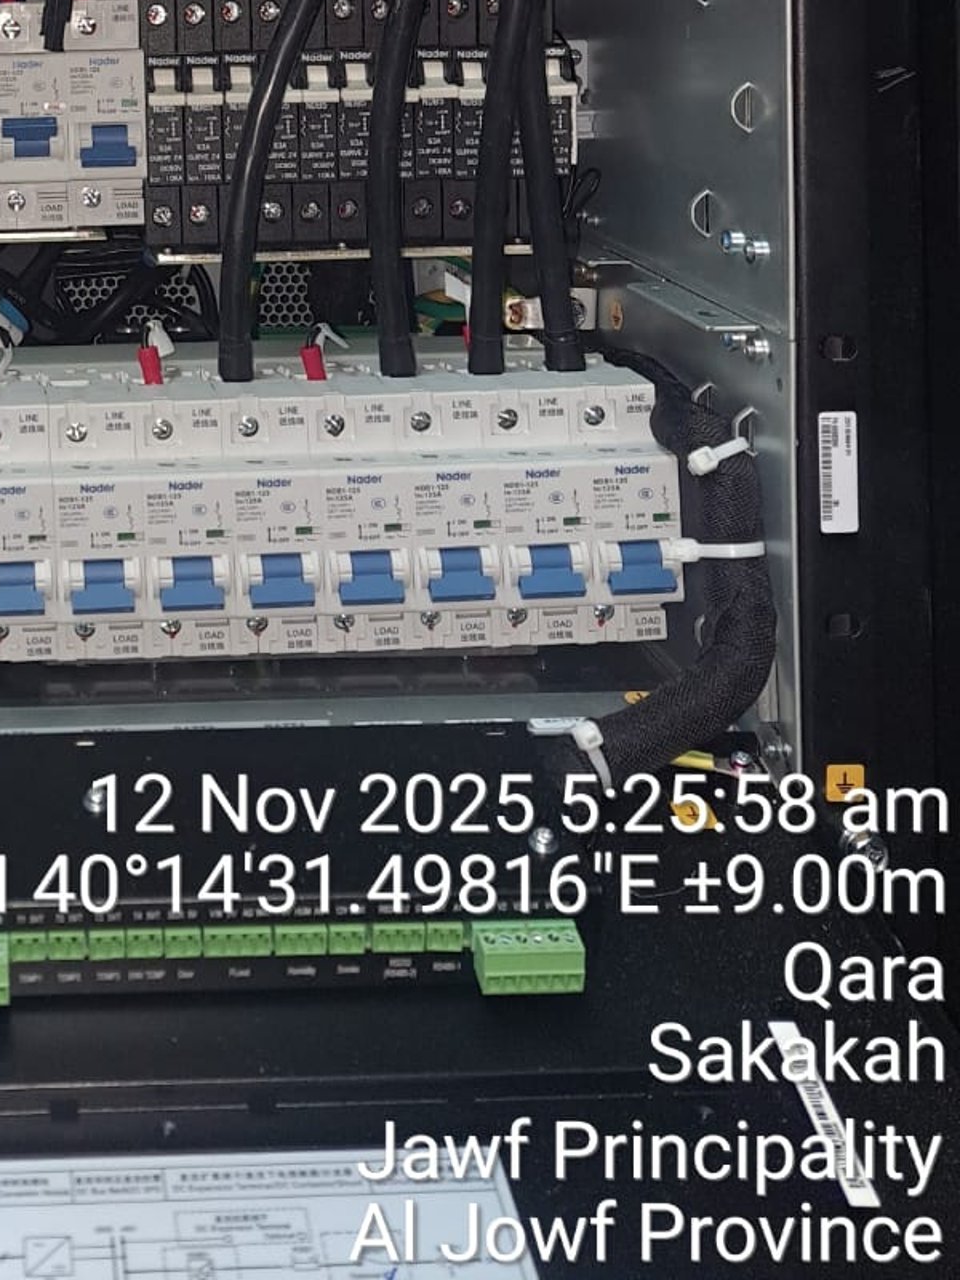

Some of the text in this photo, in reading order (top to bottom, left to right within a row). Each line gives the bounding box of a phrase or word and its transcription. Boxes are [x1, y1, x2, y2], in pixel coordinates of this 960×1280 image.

[225, 54, 257, 63] Nader
[302, 53, 333, 62] Nader
[340, 51, 372, 60] Nader
[418, 50, 448, 58] Nader
[148, 57, 180, 66] Nader
[187, 56, 218, 65] Nader
[452, 399, 472, 409] LINE
[539, 398, 558, 407] LINE
[192, 408, 212, 417] LINE
[278, 406, 299, 415] LINE
[364, 403, 385, 413] LINE
[19, 414, 39, 423] LINE
[105, 411, 125, 420] LINE
[525, 469, 561, 480] Nader
[614, 464, 650, 476] Nader
[347, 474, 383, 486] Nader
[436, 472, 472, 483] Nader
[168, 481, 204, 492] Nader
[257, 478, 292, 489] Nader
[80, 483, 116, 494] Nader
[547, 620, 573, 630] LOAD
[635, 617, 661, 626] LOAD
[374, 626, 399, 636] LOAD
[460, 622, 486, 632] LOAD
[113, 634, 139, 643] LOAD
[199, 631, 225, 641] LOAD
[287, 629, 313, 639] LOAD
[26, 636, 52, 645] LOAD
